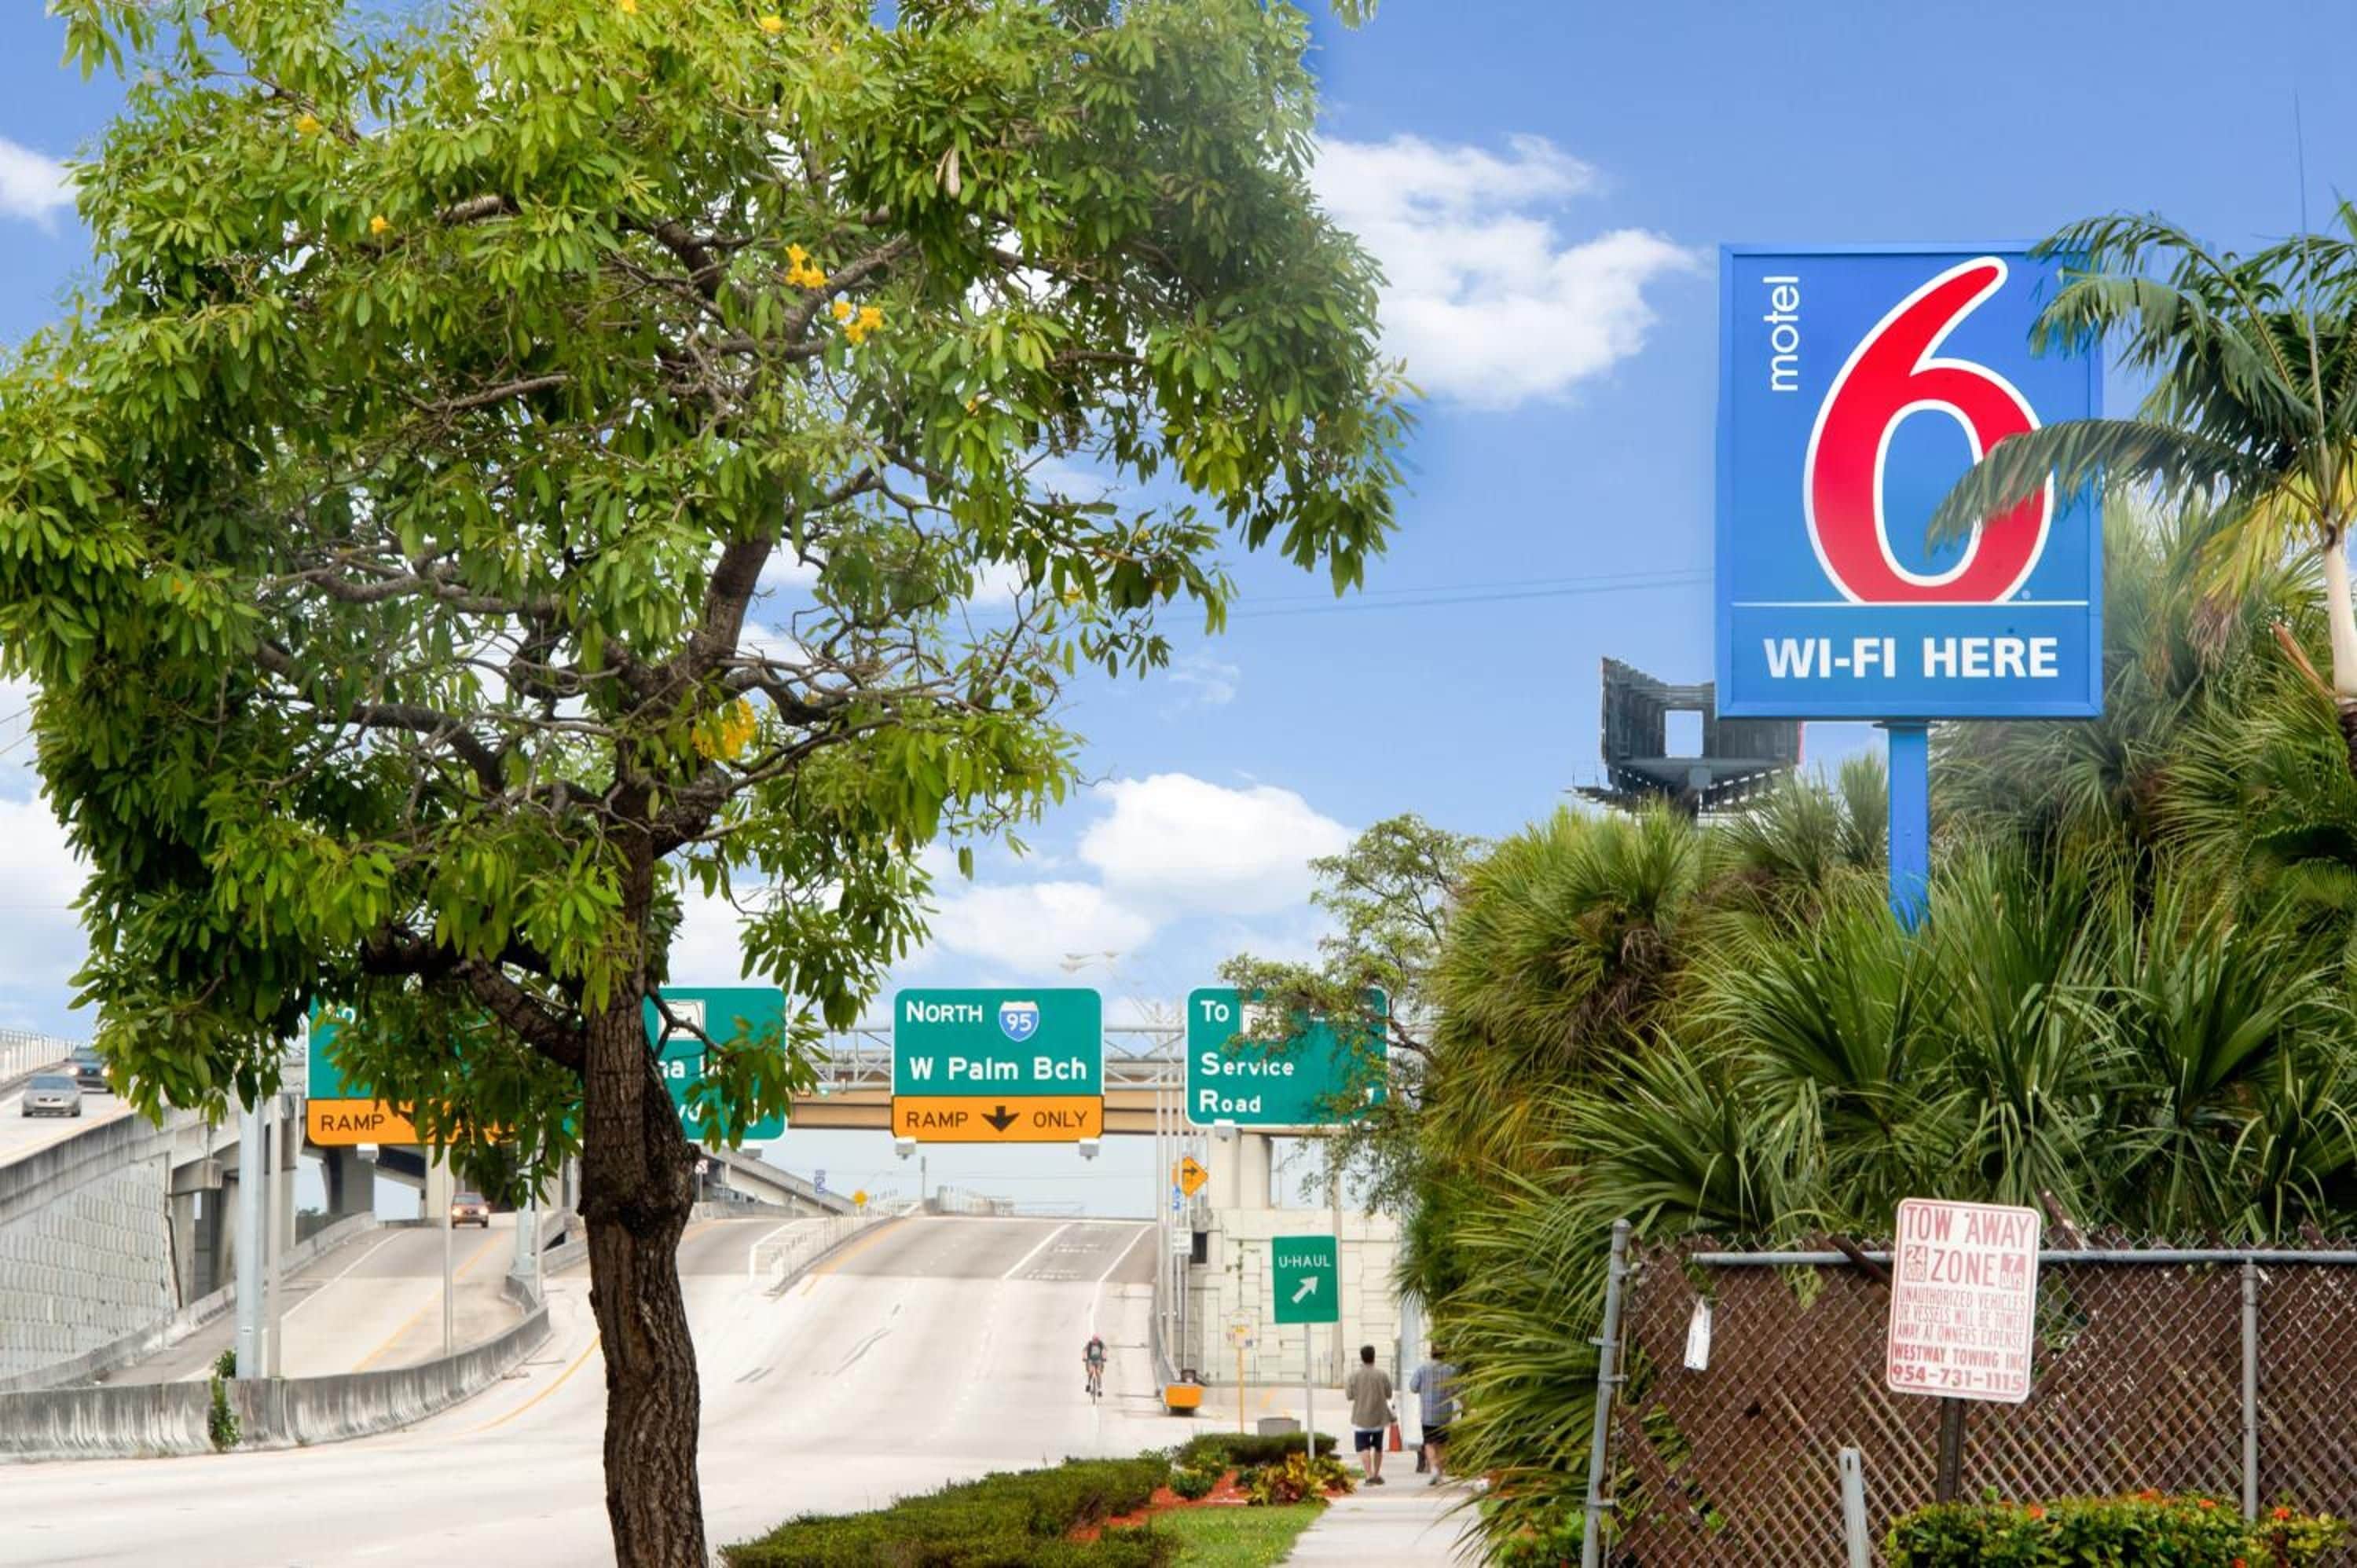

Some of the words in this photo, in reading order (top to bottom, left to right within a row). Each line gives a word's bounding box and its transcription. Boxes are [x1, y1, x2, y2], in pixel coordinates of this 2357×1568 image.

[1763, 276, 1799, 391] motel
[1802, 255, 2055, 603] 6
[1763, 638, 1896, 678] WI-FI
[1924, 637, 2058, 678] HERE
[906, 1001, 982, 1022] NORTH
[1006, 1013, 1032, 1031] 95
[909, 1057, 933, 1080] W
[948, 1057, 1018, 1080] Palm
[1033, 1056, 1087, 1080] Bch
[1200, 1052, 1294, 1076] Service
[1199, 1090, 1262, 1113] Road
[321, 1114, 384, 1131] RAMP
[906, 1112, 968, 1128] RAMP
[1033, 1111, 1087, 1128] ONLY
[1907, 1207, 1953, 1242] TOW
[1965, 1211, 2031, 1248] AWAY
[1278, 1254, 1332, 1268] U-HAUL
[1930, 1248, 1996, 1287] ZONE
[1899, 1286, 1973, 1308] UNAUTHORIZED
[1979, 1291, 2026, 1311] VEHICLES
[1913, 1305, 1950, 1324] VESSELS
[1981, 1330, 2024, 1350] EXPENSE
[1894, 1343, 1946, 1363] WESTWAY
[1953, 1348, 2000, 1368] TOWING
[2005, 1354, 2025, 1371] INC
[1892, 1364, 2025, 1391] 954-731-1115
